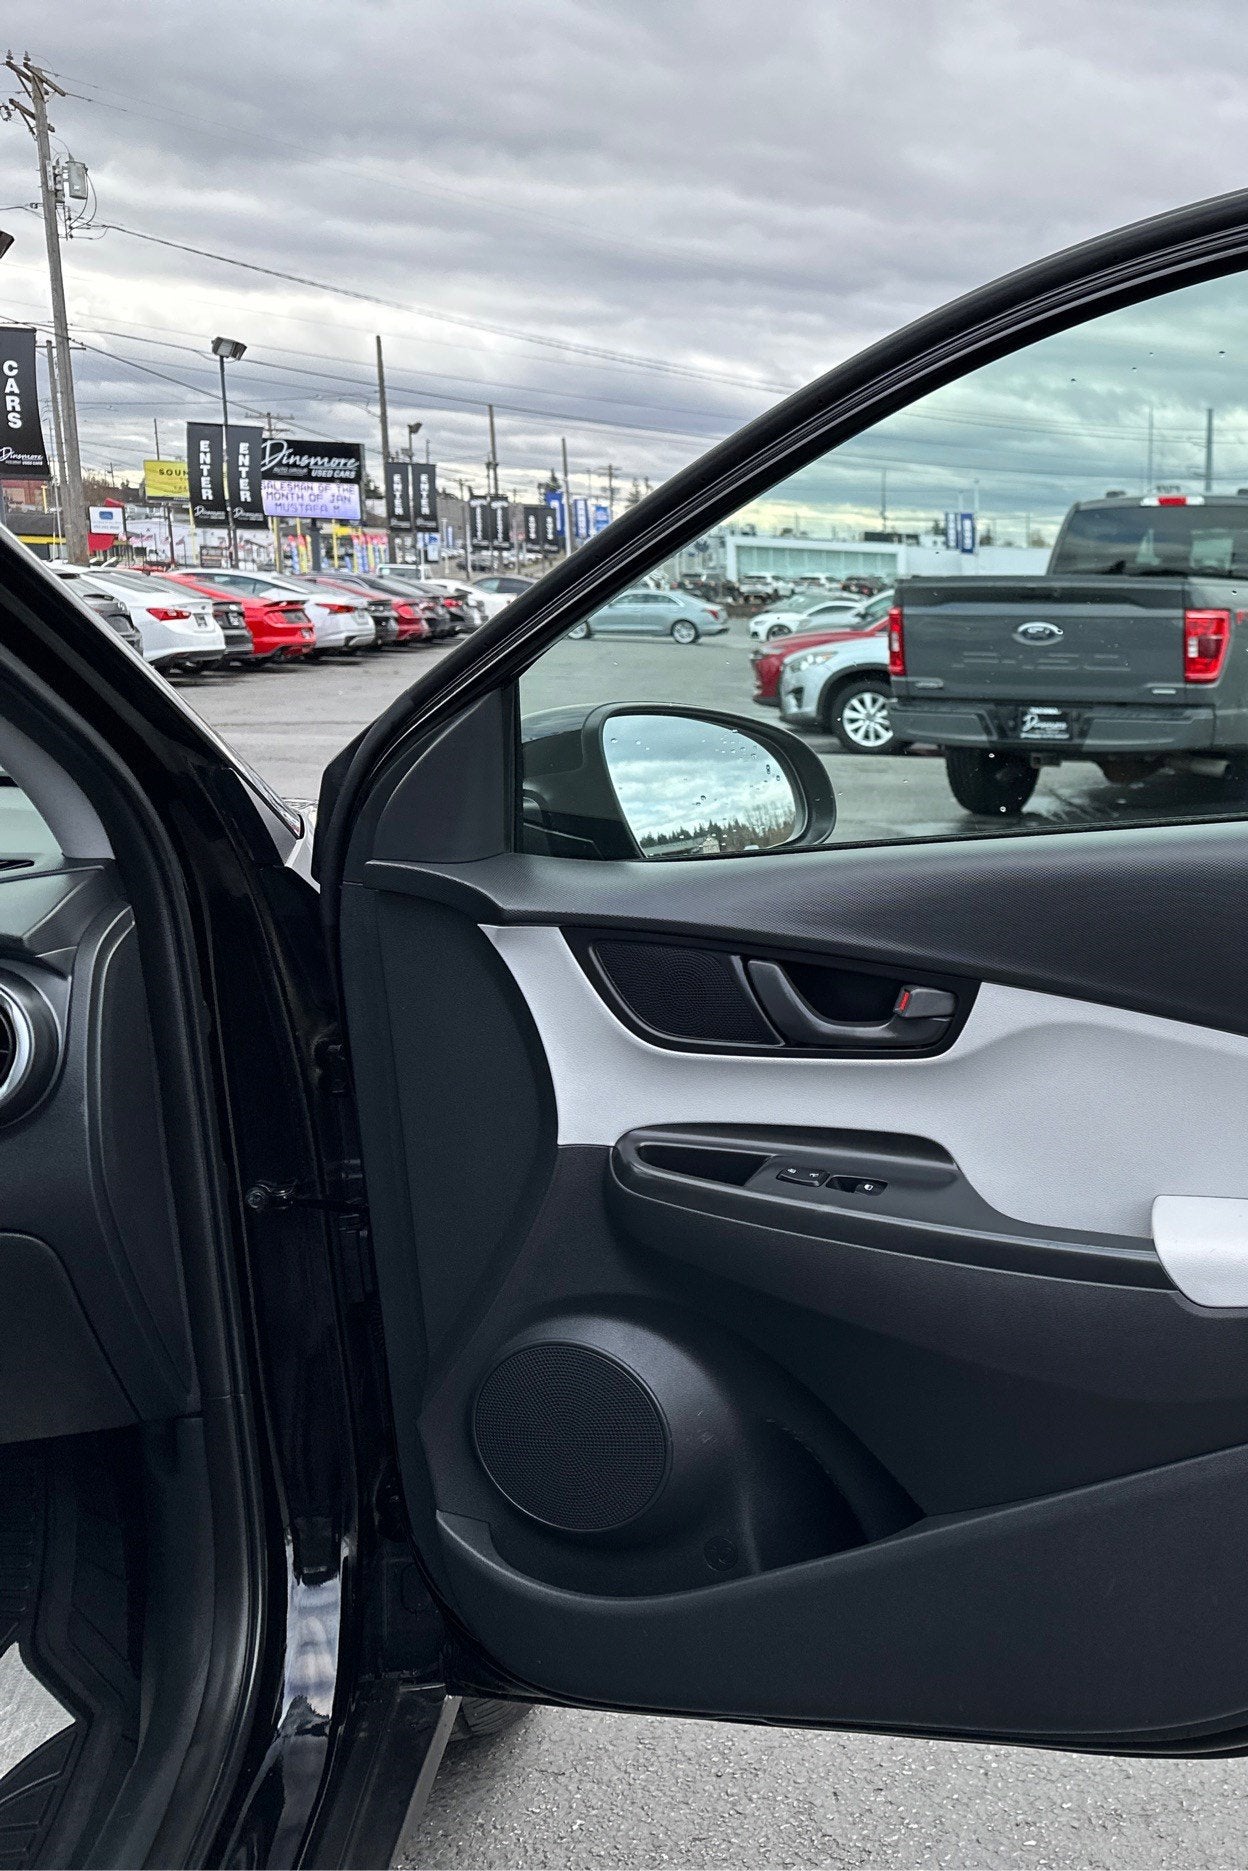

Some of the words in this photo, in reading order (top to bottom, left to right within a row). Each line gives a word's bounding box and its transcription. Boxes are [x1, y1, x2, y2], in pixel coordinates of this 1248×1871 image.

[3, 360, 22, 429] CARS
[200, 440, 214, 501] ENTER
[238, 442, 252, 502] ENTER
[261, 440, 360, 472] Dinsmore
[261, 480, 314, 491] SALESMAN
[318, 483, 331, 493] OF
[337, 484, 355, 494] THE
[311, 469, 334, 477] USED
[334, 470, 356, 479] CARS
[266, 492, 304, 501] MONTH
[309, 493, 323, 502] OF
[331, 494, 351, 504] JAN
